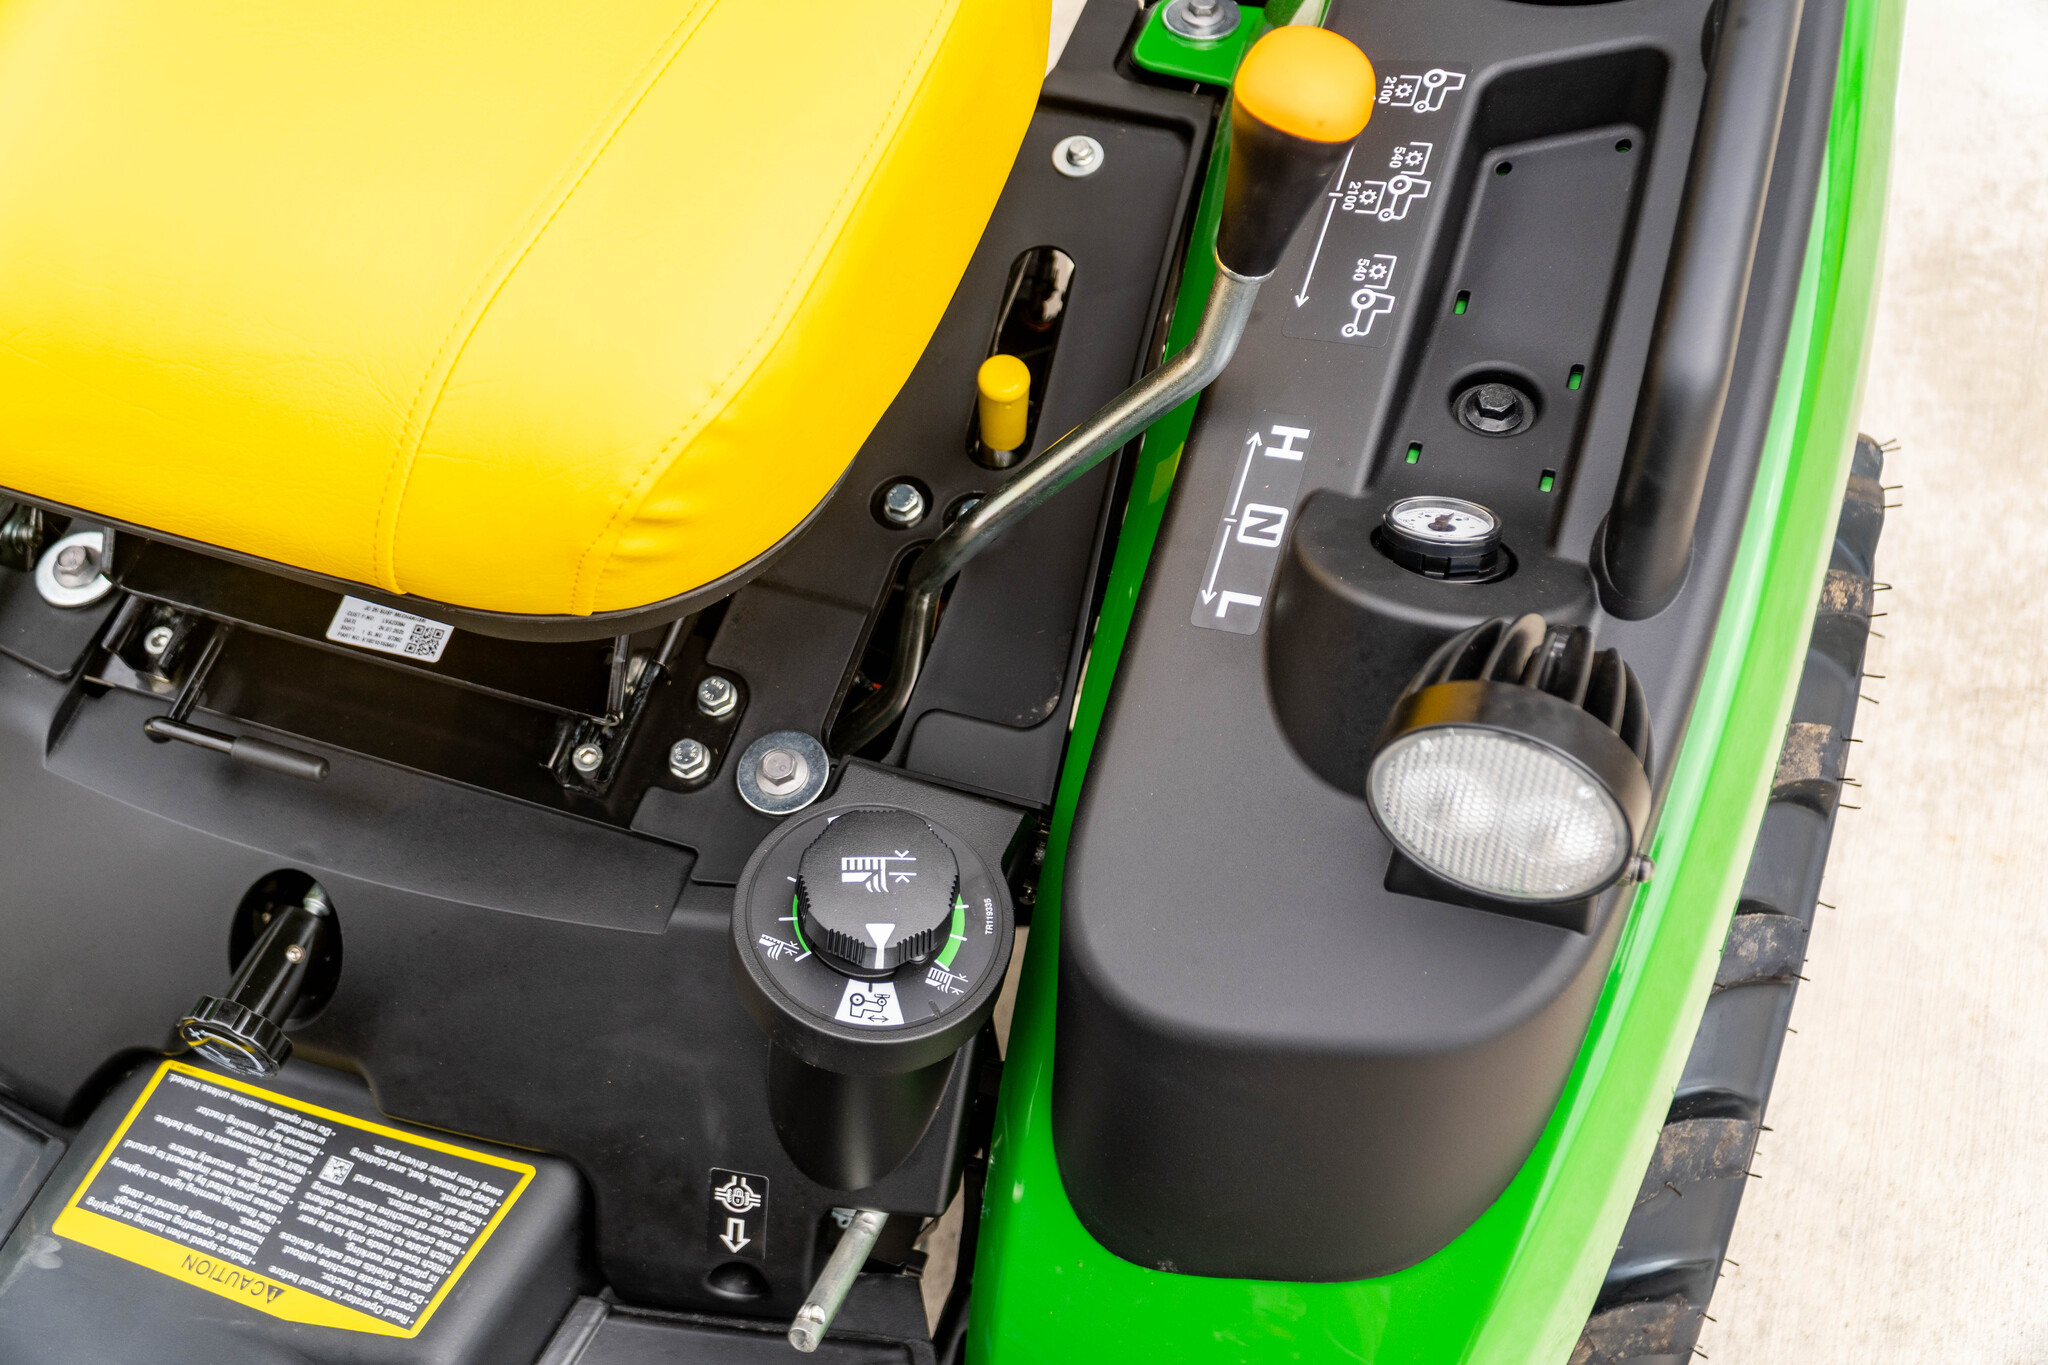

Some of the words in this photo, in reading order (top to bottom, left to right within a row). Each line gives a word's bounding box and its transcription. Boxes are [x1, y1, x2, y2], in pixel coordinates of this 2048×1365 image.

[1378, 76, 1397, 104] 2100
[1389, 146, 1406, 168] 540
[1342, 181, 1362, 211] 2100
[1352, 258, 1371, 282] 540
[1264, 424, 1311, 461] H
[1243, 509, 1283, 541] N
[1215, 590, 1263, 618] L
[983, 897, 994, 935] TR119335
[169, 1074, 201, 1090] trained.
[200, 1084, 230, 1099] unless
[229, 1094, 268, 1112] machine
[195, 1106, 226, 1122] tractor
[267, 1108, 301, 1124] operate
[154, 1115, 184, 1131] before
[183, 1123, 204, 1136] stop
[225, 1114, 259, 1133] leaving
[300, 1120, 318, 1130] not
[318, 1126, 332, 1136] Do
[203, 1131, 215, 1141] to
[225, 1127, 273, 1149] machinery.
[256, 1128, 267, 1136] if
[266, 1129, 284, 1144] key
[272, 1122, 326, 1144] unattended.
[123, 1139, 157, 1155] ground
[168, 1143, 198, 1159] before
[213, 1135, 261, 1159] movement
[272, 1143, 316, 1164] servicing
[280, 1137, 320, 1156] Remove
[374, 1145, 400, 1159] parts.
[155, 1150, 166, 1160] to
[197, 1152, 236, 1171] securely
[258, 1152, 273, 1161] all
[272, 1157, 287, 1168] for
[350, 1147, 388, 1166] clothing
[399, 1155, 428, 1170] driven
[110, 1157, 147, 1177] highway
[164, 1153, 211, 1176] implement
[247, 1157, 304, 1184] dismounting.
[286, 1161, 307, 1175] Wait
[386, 1162, 406, 1173] and
[428, 1165, 458, 1179] power
[146, 1171, 160, 1180] on
[177, 1169, 195, 1183] law.
[191, 1174, 208, 1187] by
[210, 1170, 236, 1185] lower
[235, 1167, 262, 1183] brake
[260, 1176, 278, 1186] set
[353, 1174, 373, 1185] and
[407, 1167, 427, 1182] feet,
[457, 1175, 479, 1189] from
[159, 1175, 186, 1191] lights
[205, 1180, 254, 1201] prohibited
[236, 1178, 268, 1195] engine,
[275, 1182, 296, 1193] and
[311, 1181, 347, 1200] starting
[372, 1181, 403, 1197] tractor
[429, 1176, 459, 1194] hands,
[479, 1182, 504, 1196] away
[118, 1184, 144, 1199] steep
[143, 1194, 155, 1203] or
[184, 1183, 221, 1203] warning
[267, 1190, 290, 1205] Stop
[304, 1192, 334, 1207] others
[402, 1192, 418, 1201] off
[457, 1188, 472, 1196] all
[470, 1192, 496, 1207] Keep
[85, 1196, 123, 1215] applying
[113, 1195, 141, 1210] rough
[153, 1198, 189, 1216] ground
[221, 1196, 258, 1218] flashing
[252, 1197, 283, 1213] unless
[298, 1201, 326, 1216] upset.
[333, 1203, 365, 1218] and/or
[347, 1195, 378, 1212] before
[388, 1197, 432, 1218] operation.
[417, 1197, 445, 1212] riders
[440, 1193, 492, 1215] equipment.
[121, 1211, 134, 1219] or
[138, 1205, 173, 1221] around
[187, 1210, 216, 1225] rough
[258, 1211, 277, 1225] Use
[377, 1206, 417, 1225] machine
[431, 1214, 443, 1222] or
[444, 1207, 458, 1216] all
[457, 1209, 482, 1226] Keep
[132, 1213, 165, 1232] turning
[172, 1215, 215, 1237] operating
[214, 1220, 229, 1230] on
[239, 1216, 273, 1233] slopes.
[297, 1214, 318, 1226] rear
[317, 1221, 334, 1233] the
[324, 1212, 367, 1231] rearward
[364, 1214, 403, 1232] children
[415, 1221, 428, 1229] of
[443, 1215, 479, 1234] engine
[164, 1226, 190, 1240] when
[213, 1233, 227, 1241] or
[228, 1225, 265, 1245] hazards
[333, 1227, 345, 1237] to
[344, 1230, 367, 1244] only
[365, 1227, 394, 1241] avoid
[402, 1228, 436, 1247] certain
[427, 1225, 452, 1238] clear
[451, 1233, 469, 1244] are
[188, 1235, 218, 1251] speed
[226, 1237, 259, 1255] brakes
[279, 1232, 315, 1250] devices
[365, 1239, 392, 1255] loads
[393, 1237, 405, 1246] to
[404, 1238, 430, 1254] plate
[435, 1240, 461, 1255] Make
[217, 1246, 252, 1265] Reduce
[282, 1245, 317, 1263] without
[314, 1243, 344, 1260] safety
[345, 1242, 383, 1262] working.
[391, 1248, 421, 1265] towed
[429, 1250, 454, 1265] hitch
[317, 1258, 357, 1277] machine
[341, 1255, 363, 1267] and
[382, 1258, 403, 1269] and
[421, 1259, 447, 1275] Hitch
[181, 1254, 266, 1296] CAUTION
[268, 1265, 300, 1283] before
[362, 1262, 397, 1279] shields
[402, 1265, 430, 1279] place
[298, 1277, 334, 1296] Manual
[321, 1272, 354, 1290] tractor.
[357, 1273, 393, 1291] operate
[398, 1274, 435, 1292] guards,
[428, 1274, 440, 1285] in
[353, 1284, 373, 1297] this
[392, 1286, 410, 1297] not
[409, 1293, 425, 1304] Do
[334, 1290, 384, 1314] Operator's
[372, 1290, 420, 1312] operating
[382, 1309, 410, 1324] Read
